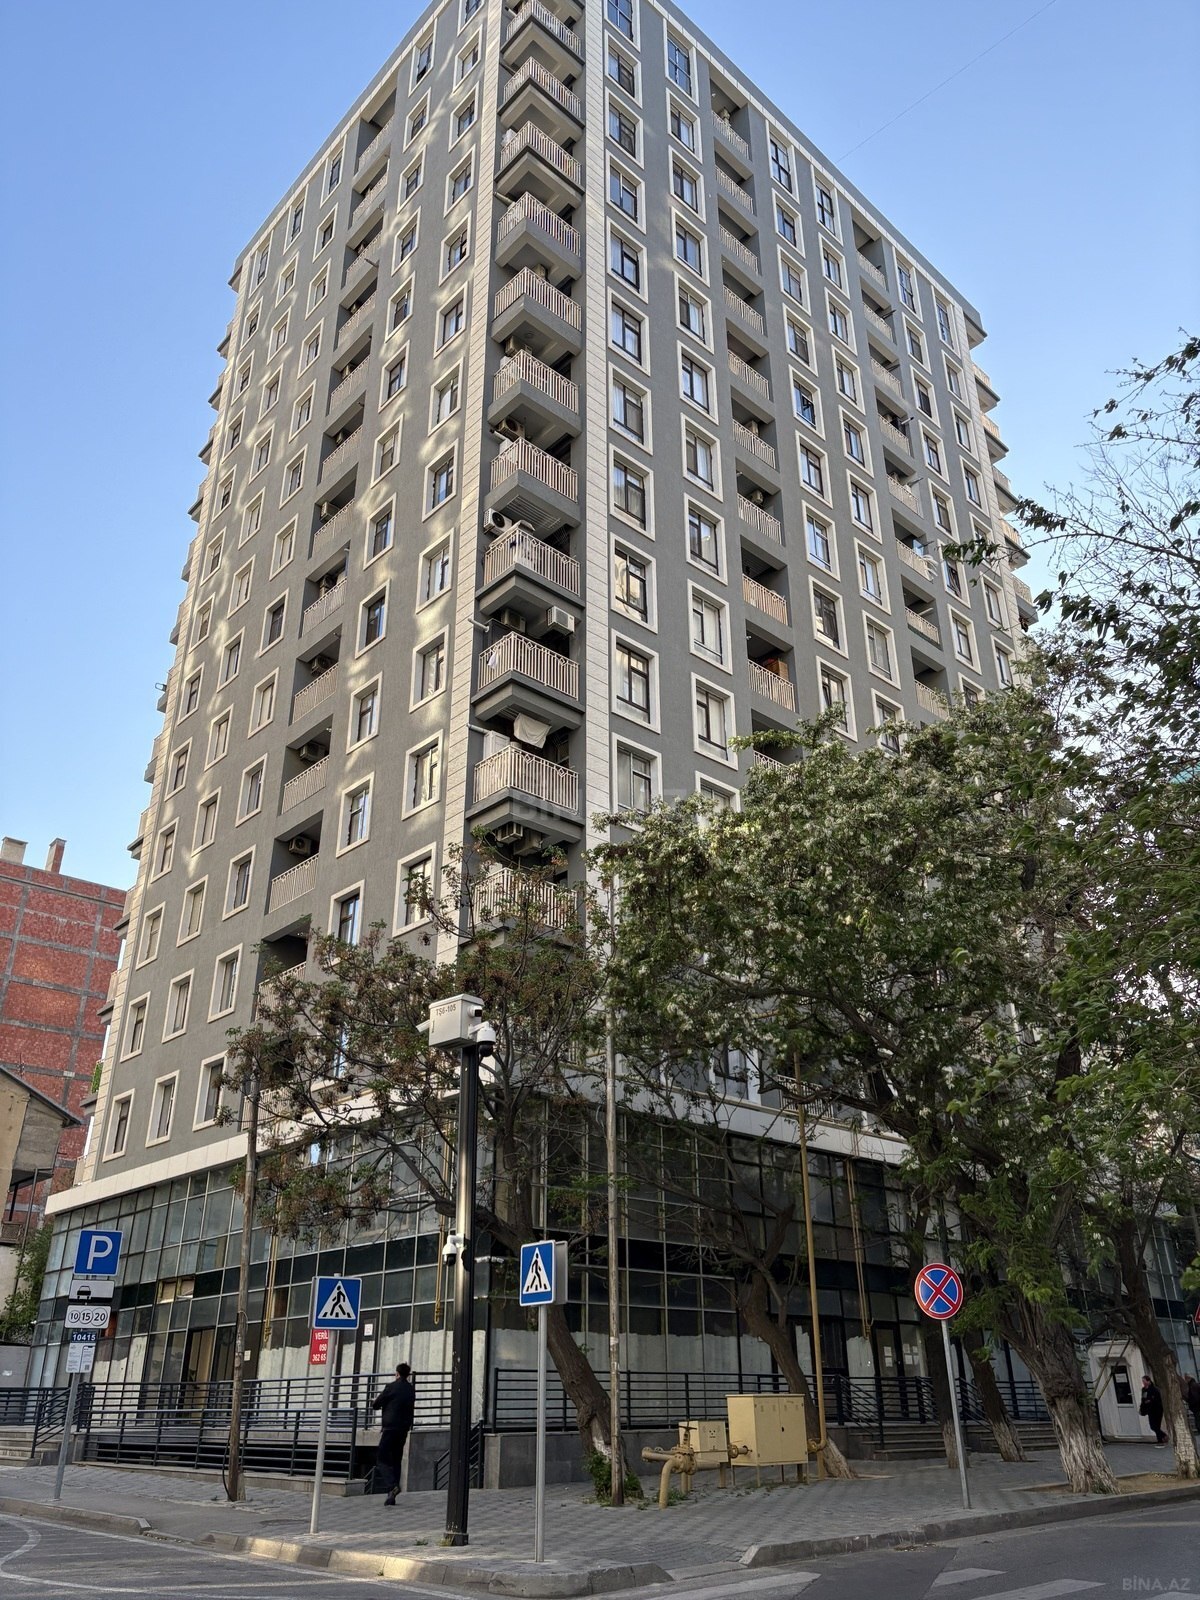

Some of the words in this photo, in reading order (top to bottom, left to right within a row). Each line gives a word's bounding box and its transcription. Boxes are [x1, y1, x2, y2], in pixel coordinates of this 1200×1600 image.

[86, 1235, 113, 1270] P
[71, 1312, 79, 1320] 10
[82, 1312, 91, 1321] 15
[94, 1312, 106, 1321] 20
